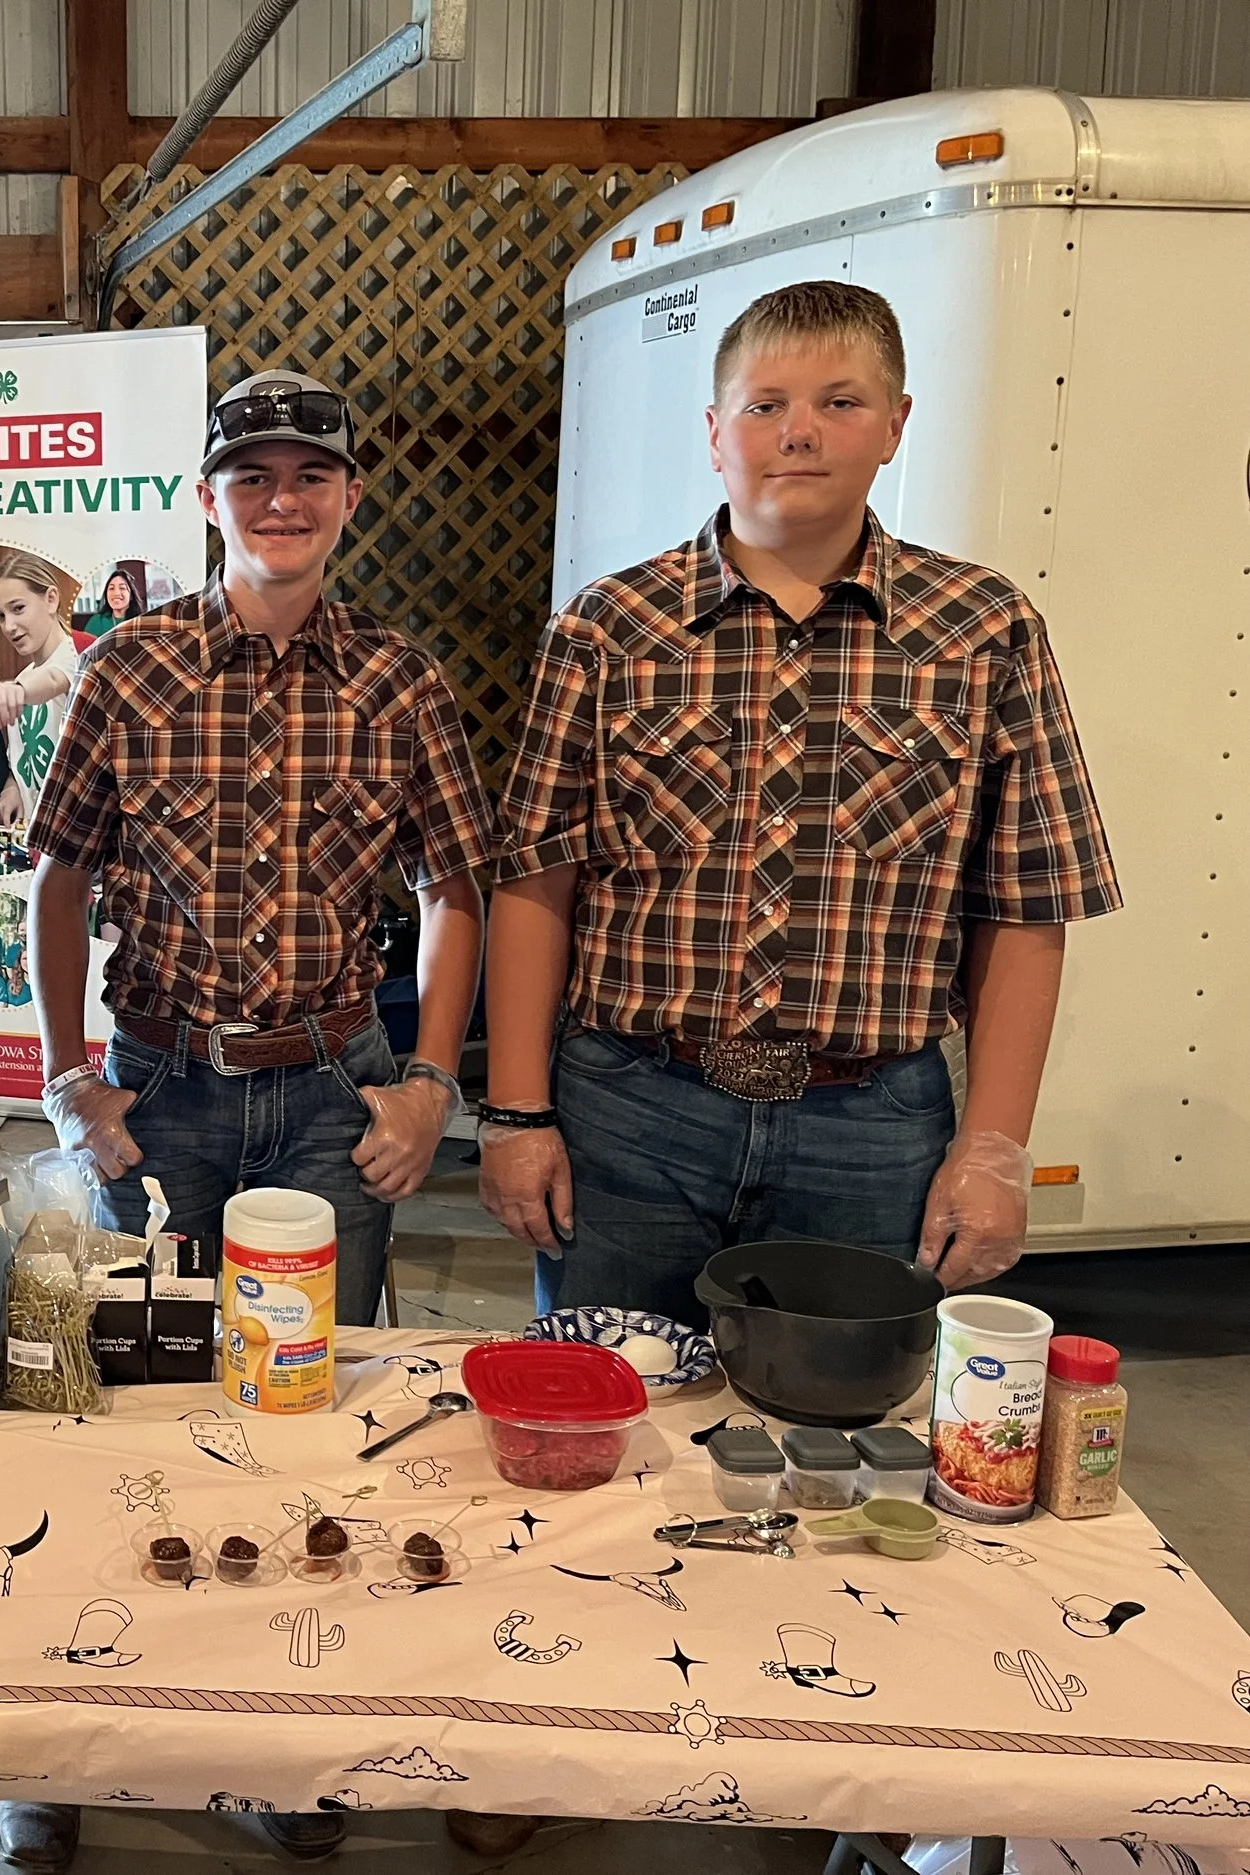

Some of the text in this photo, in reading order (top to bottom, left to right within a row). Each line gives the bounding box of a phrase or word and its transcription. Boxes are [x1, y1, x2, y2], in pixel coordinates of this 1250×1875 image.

[645, 284, 698, 316] Continental
[668, 313, 695, 333] Cargo
[766, 1049, 789, 1057] FAIR
[717, 1068, 744, 1080] 2022
[248, 1301, 303, 1315] Disinfecting
[185, 1336, 203, 1344] Cups
[970, 1359, 998, 1372] Great
[976, 1368, 998, 1376] Value
[242, 1382, 256, 1398] 75
[999, 1381, 1026, 1390] Italian
[1080, 1450, 1117, 1465] GARLIC
